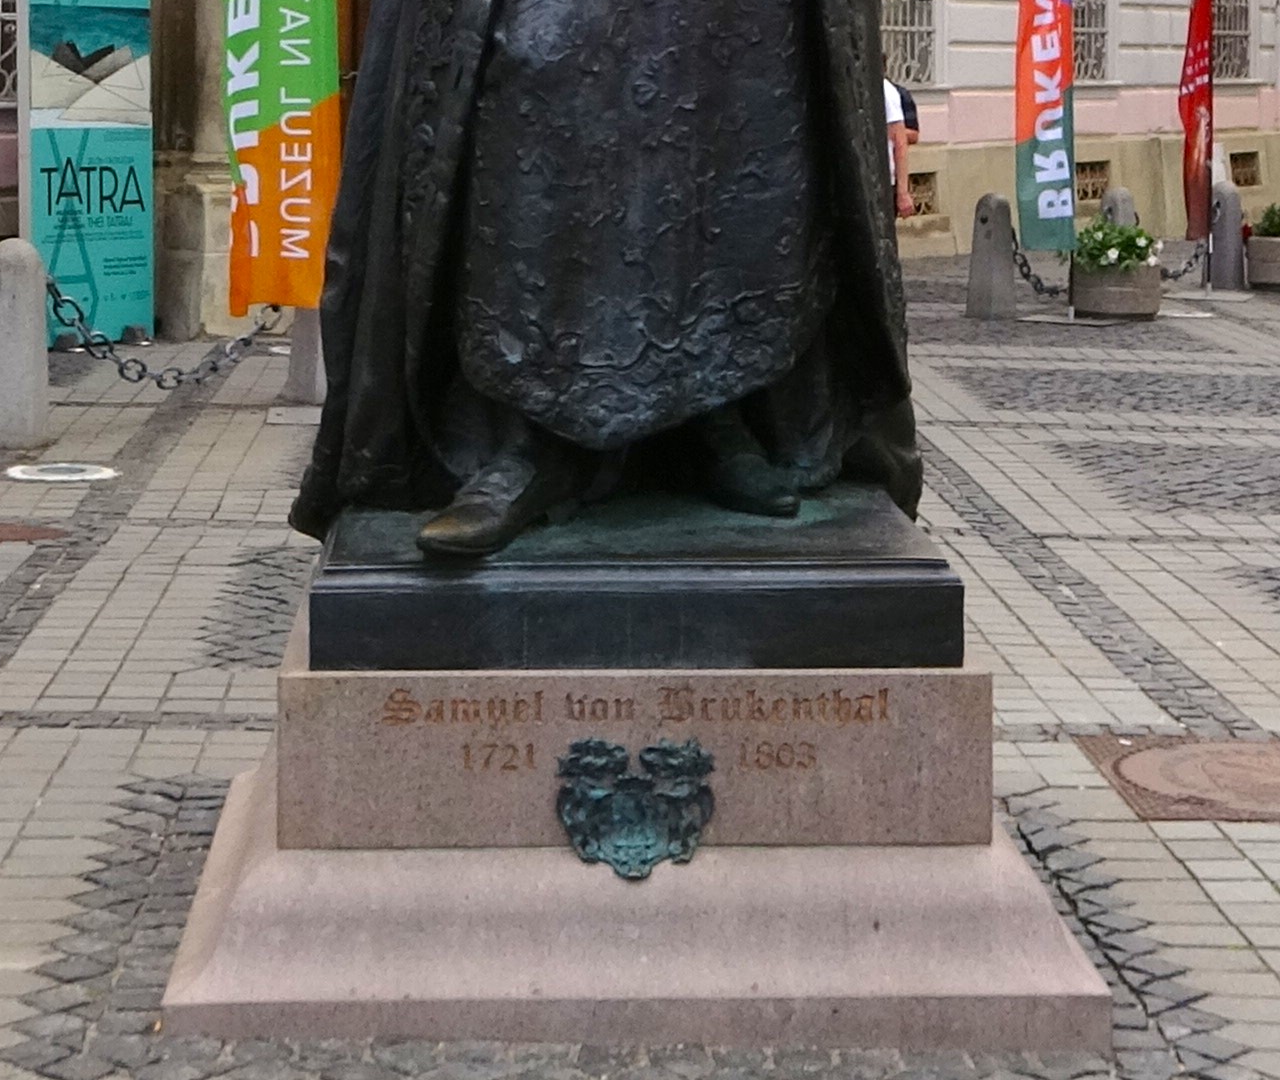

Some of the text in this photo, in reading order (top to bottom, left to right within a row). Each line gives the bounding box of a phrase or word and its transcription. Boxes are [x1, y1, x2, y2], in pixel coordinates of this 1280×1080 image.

[40, 156, 146, 216] TATRA
[565, 692, 635, 722] von
[657, 686, 890, 728] Brukenthal
[463, 741, 817, 771] 1721 1803
